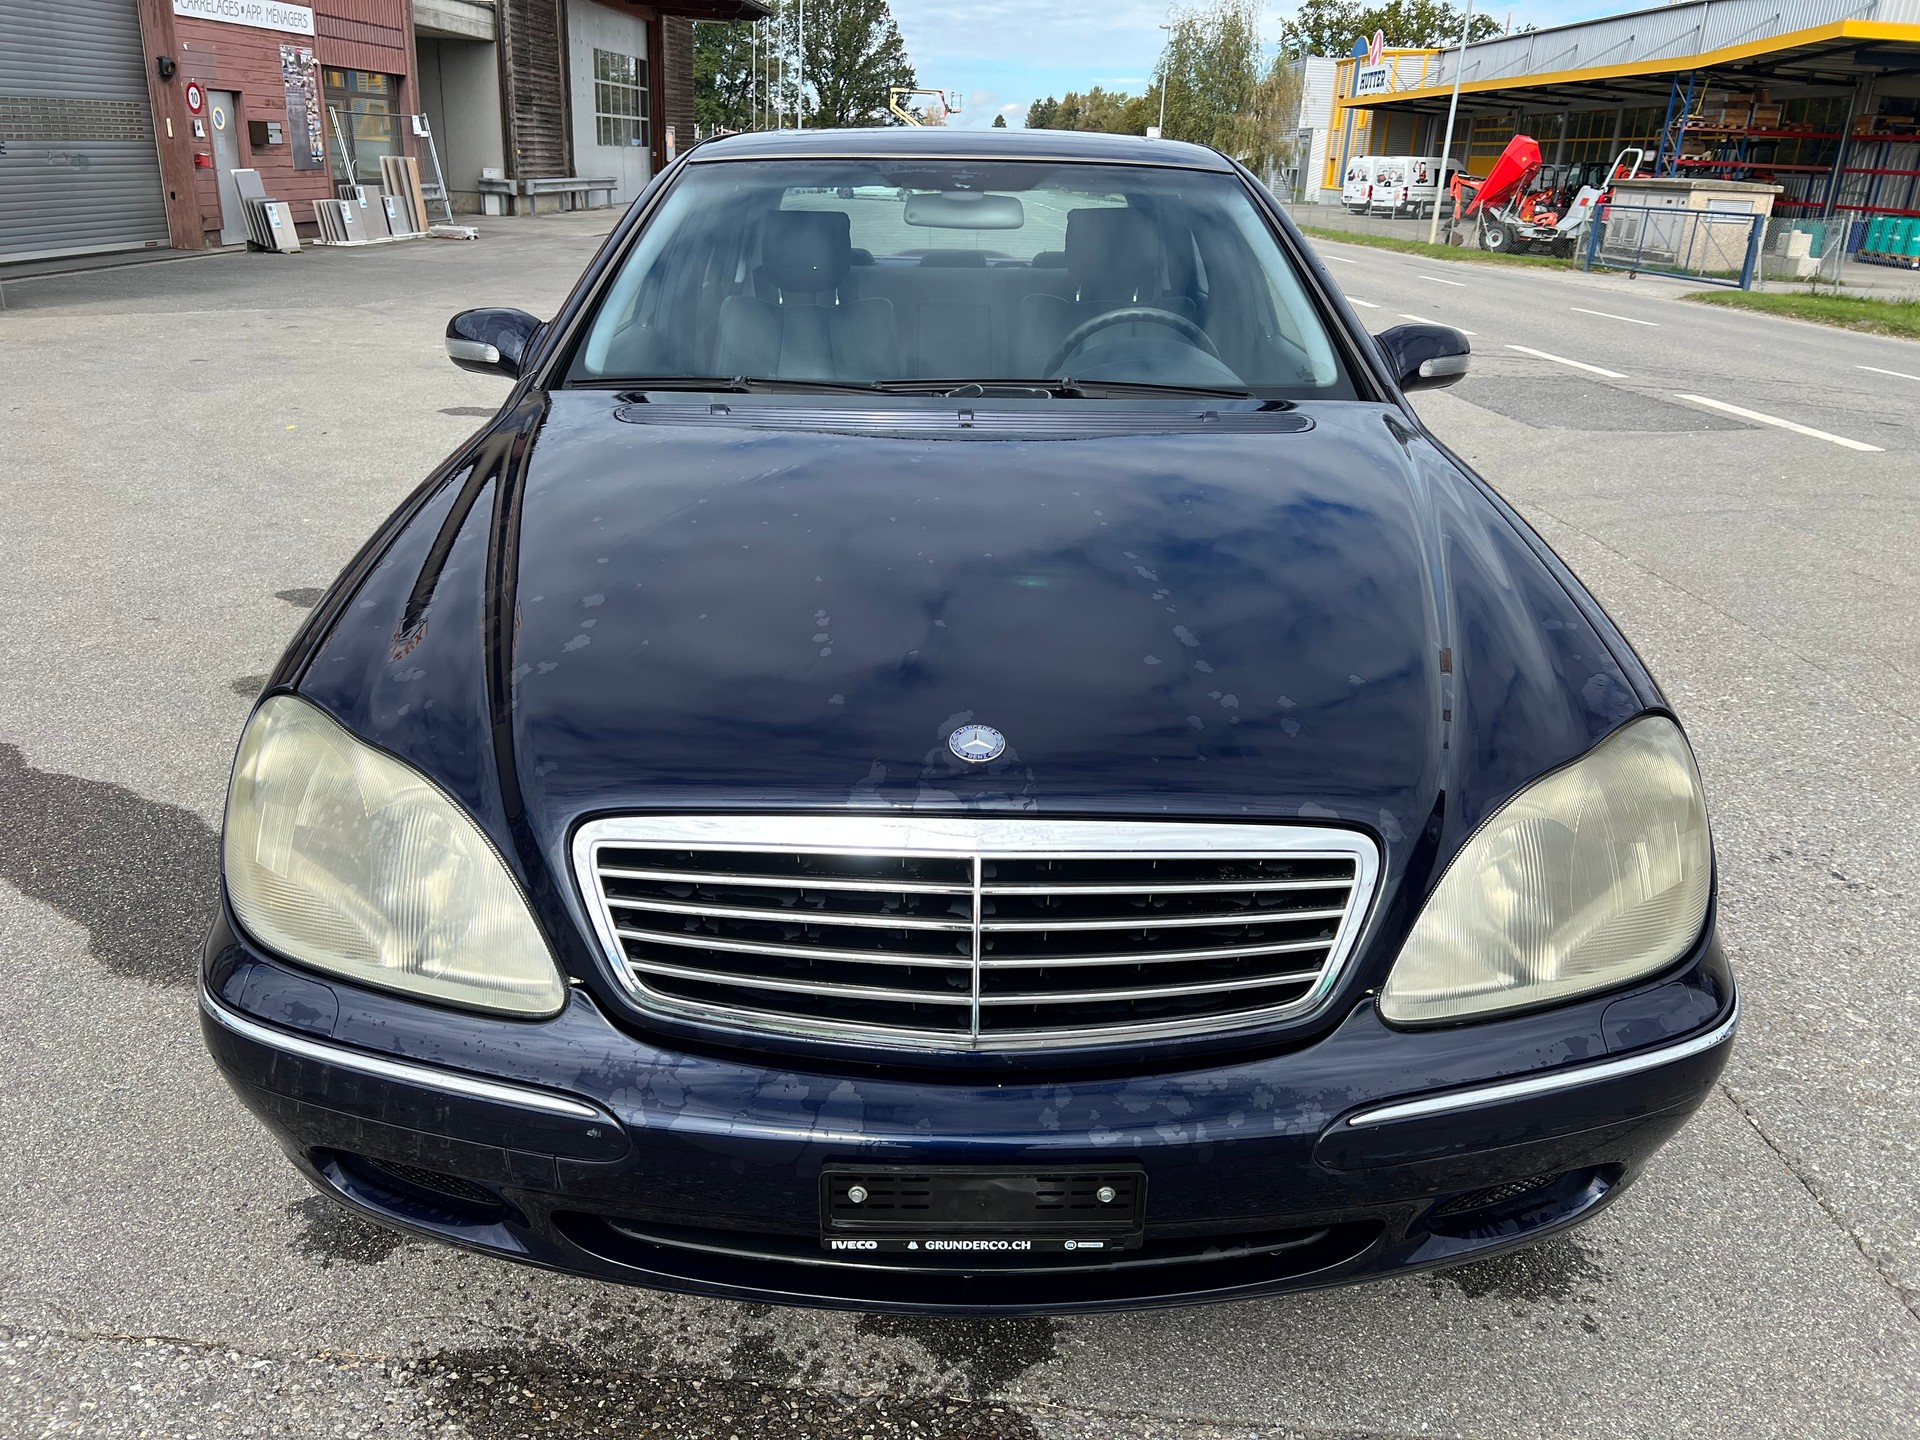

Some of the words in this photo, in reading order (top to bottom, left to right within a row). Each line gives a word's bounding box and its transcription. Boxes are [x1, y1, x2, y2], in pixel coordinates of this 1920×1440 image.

[180, 0, 240, 17] CARRELAGES
[245, 4, 263, 21] APP.
[265, 5, 308, 29] MÉNAGERS
[1359, 69, 1386, 91] HUTTER
[190, 92, 199, 105] 10
[831, 1240, 878, 1250] IVECO
[924, 1240, 1032, 1251] GRUNDERCO.CH
